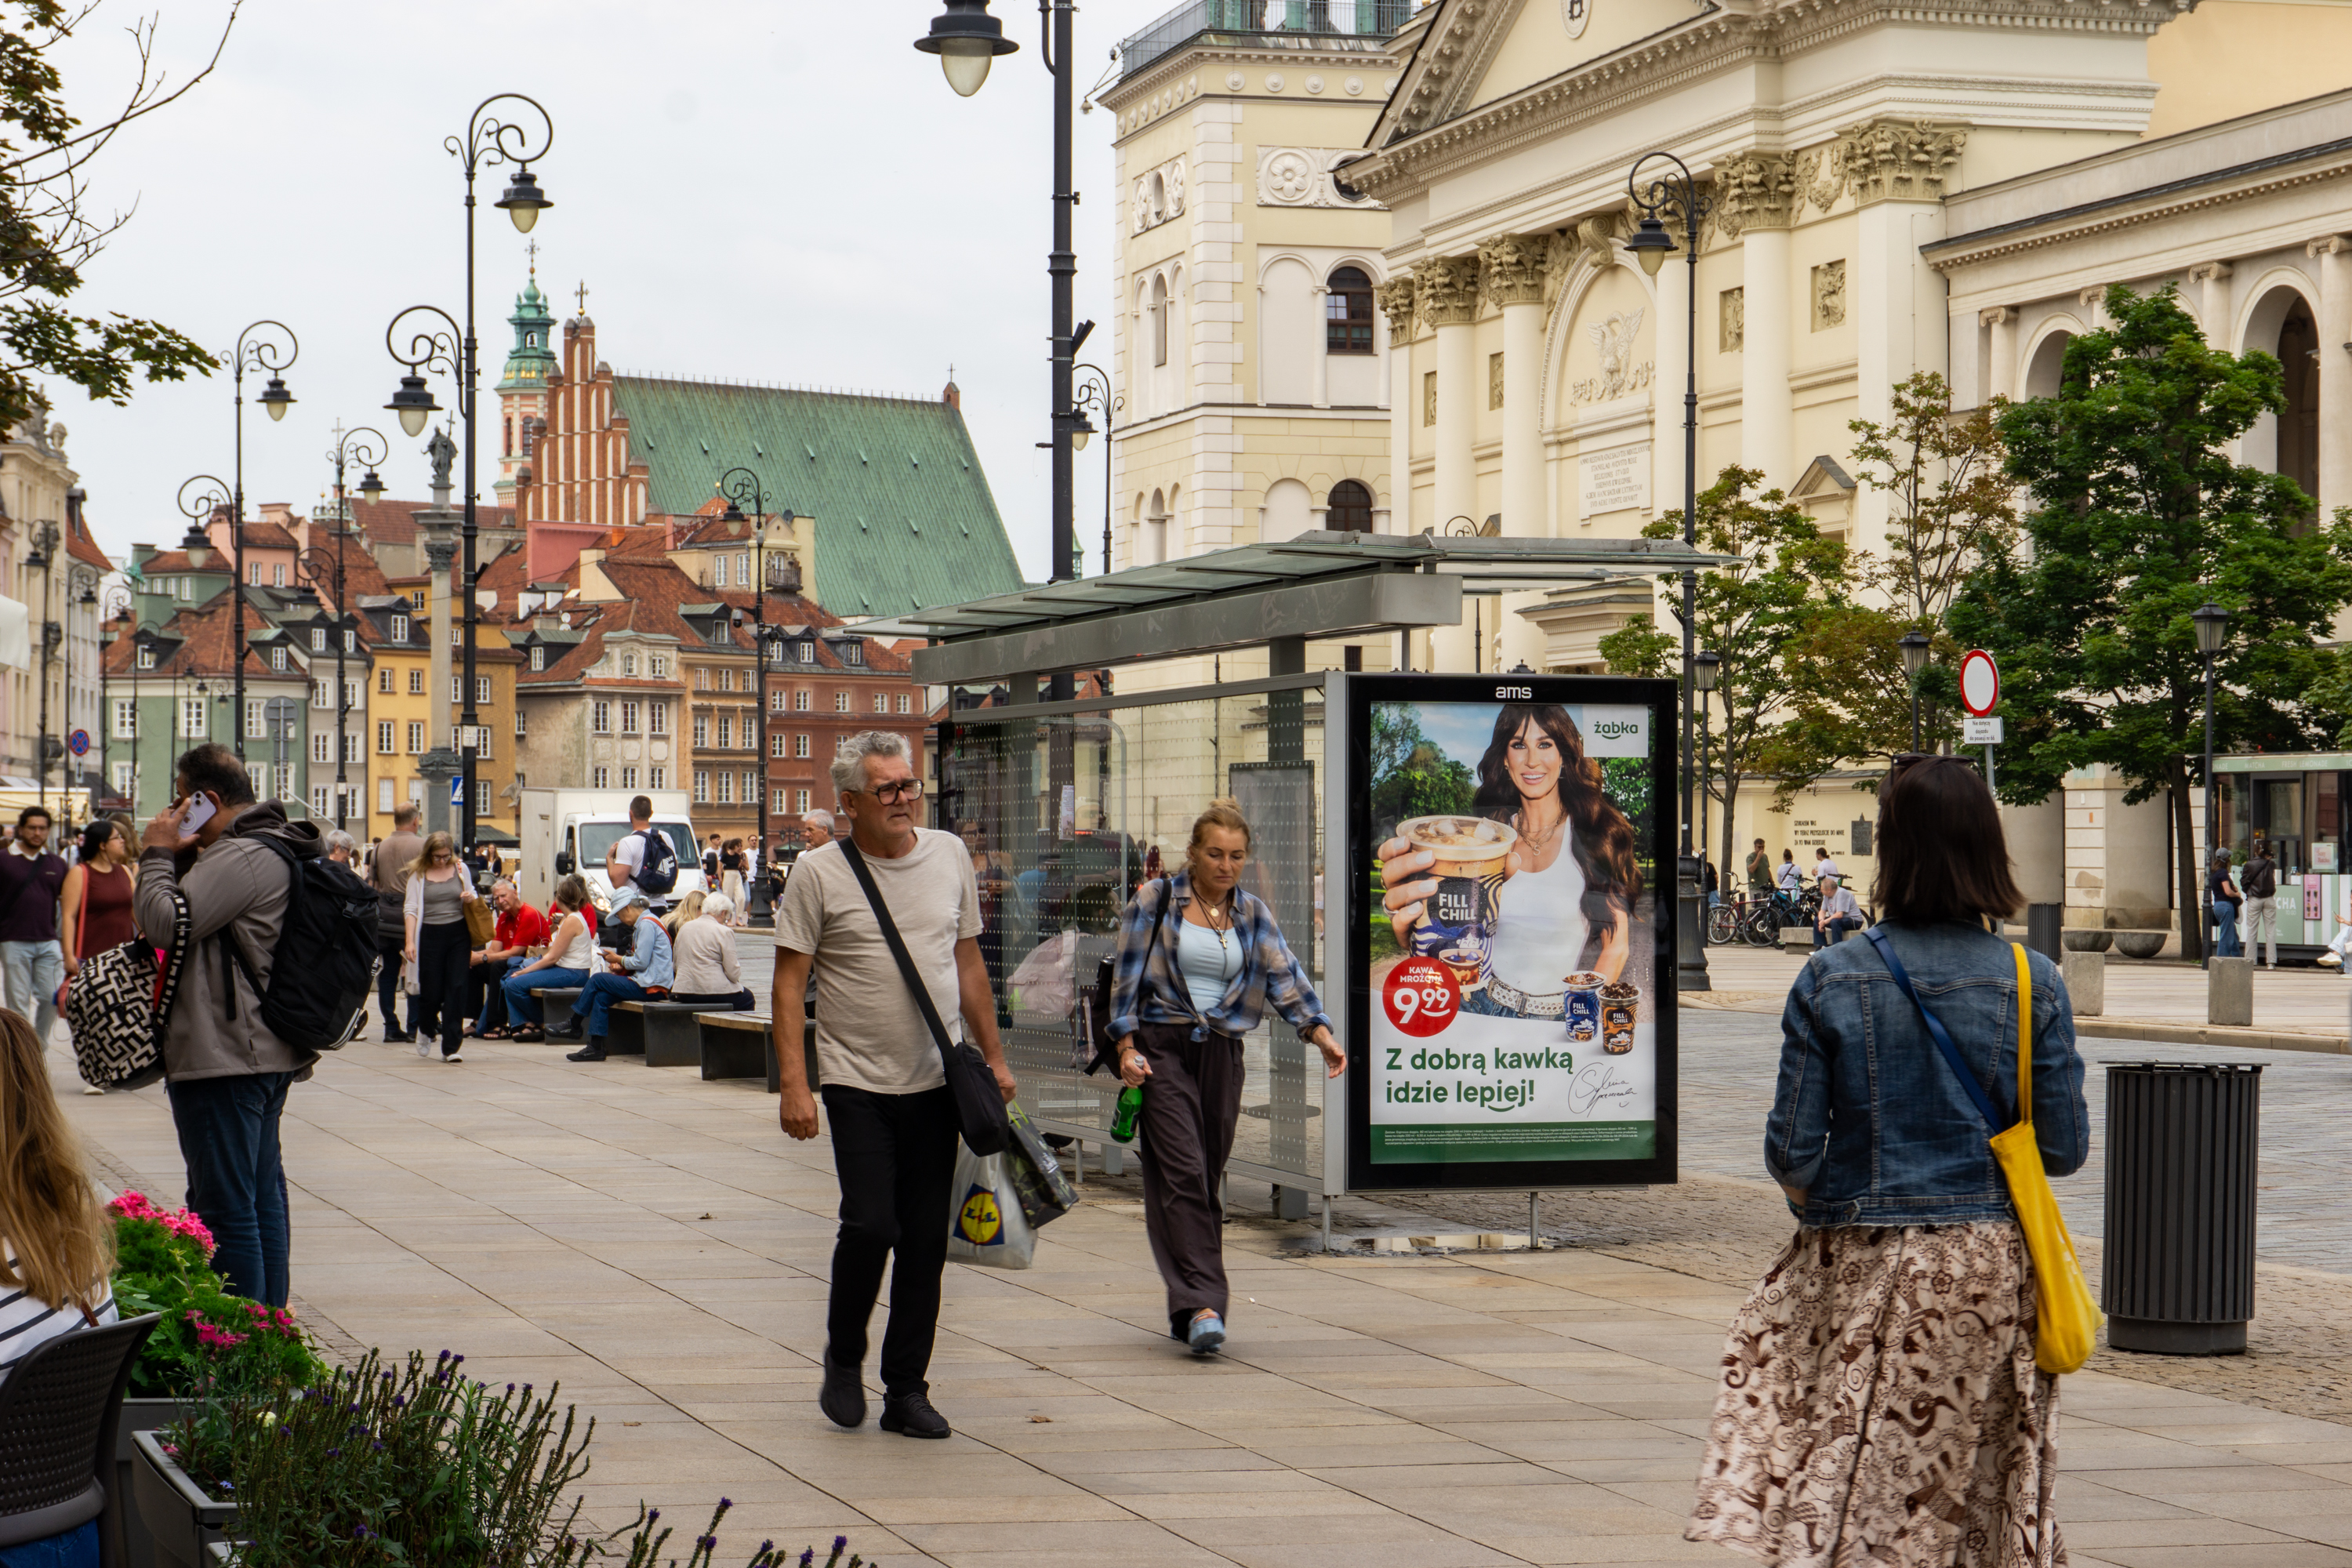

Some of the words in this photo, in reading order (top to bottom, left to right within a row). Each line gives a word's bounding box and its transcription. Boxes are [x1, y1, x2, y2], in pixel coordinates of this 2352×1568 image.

[1495, 686, 1532, 699] ams
[1594, 721, 1638, 734] żabka
[1439, 893, 1468, 908] FILL
[2274, 897, 2296, 909] CHA
[1439, 908, 1476, 921] CHILL
[1400, 973, 1444, 983] MROŻONA
[1386, 1048, 1402, 1070] Z
[1410, 1048, 1486, 1075] dobrą
[1495, 1047, 1573, 1075] kawką
[1386, 1081, 1448, 1103] idzie
[1457, 1080, 1535, 1107] lepiej!
